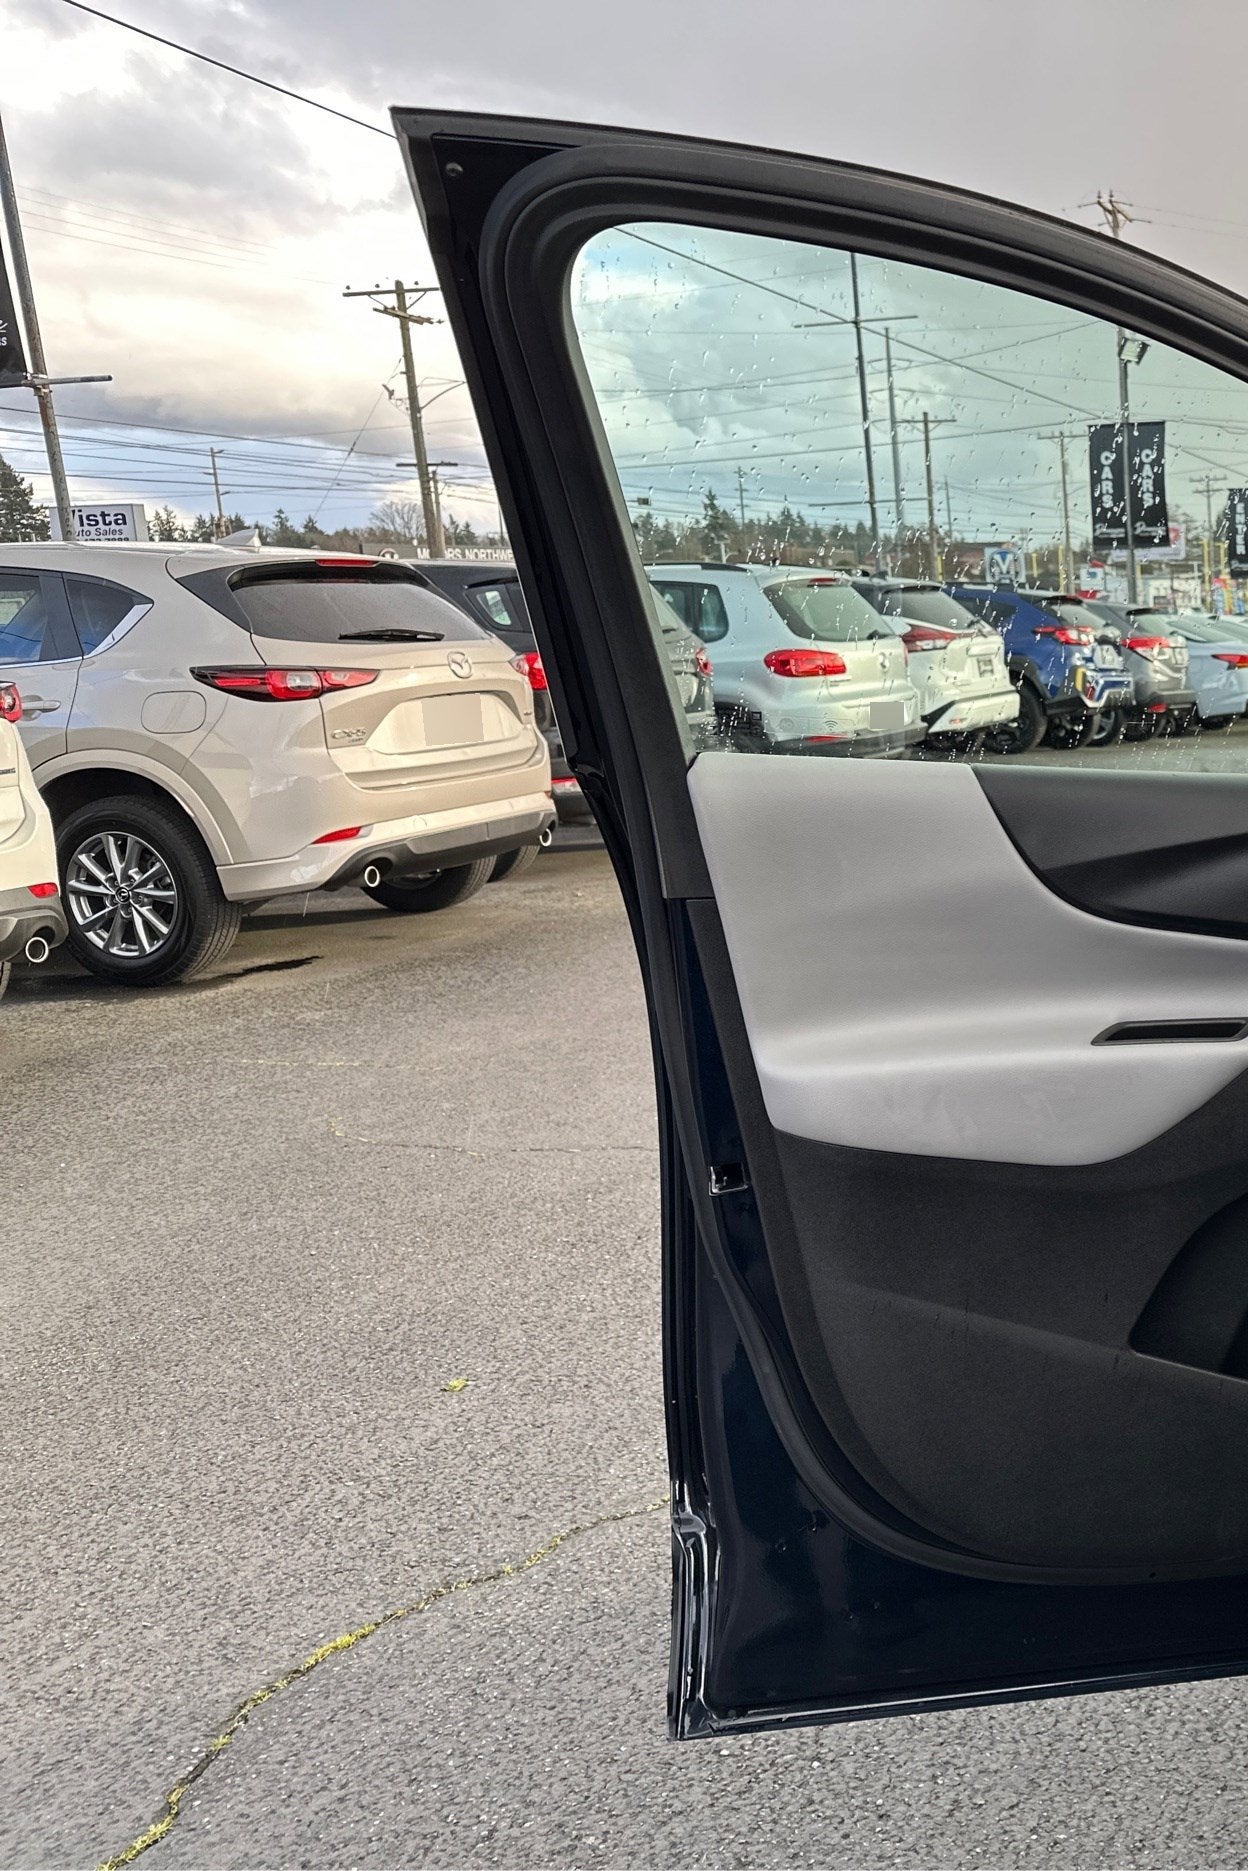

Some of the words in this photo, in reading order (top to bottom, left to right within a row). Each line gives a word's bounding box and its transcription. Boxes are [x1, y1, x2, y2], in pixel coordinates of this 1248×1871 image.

[1100, 450, 1114, 508] CARS
[1140, 448, 1155, 507] CARS
[76, 530, 92, 538] uto
[94, 527, 124, 537] Sales
